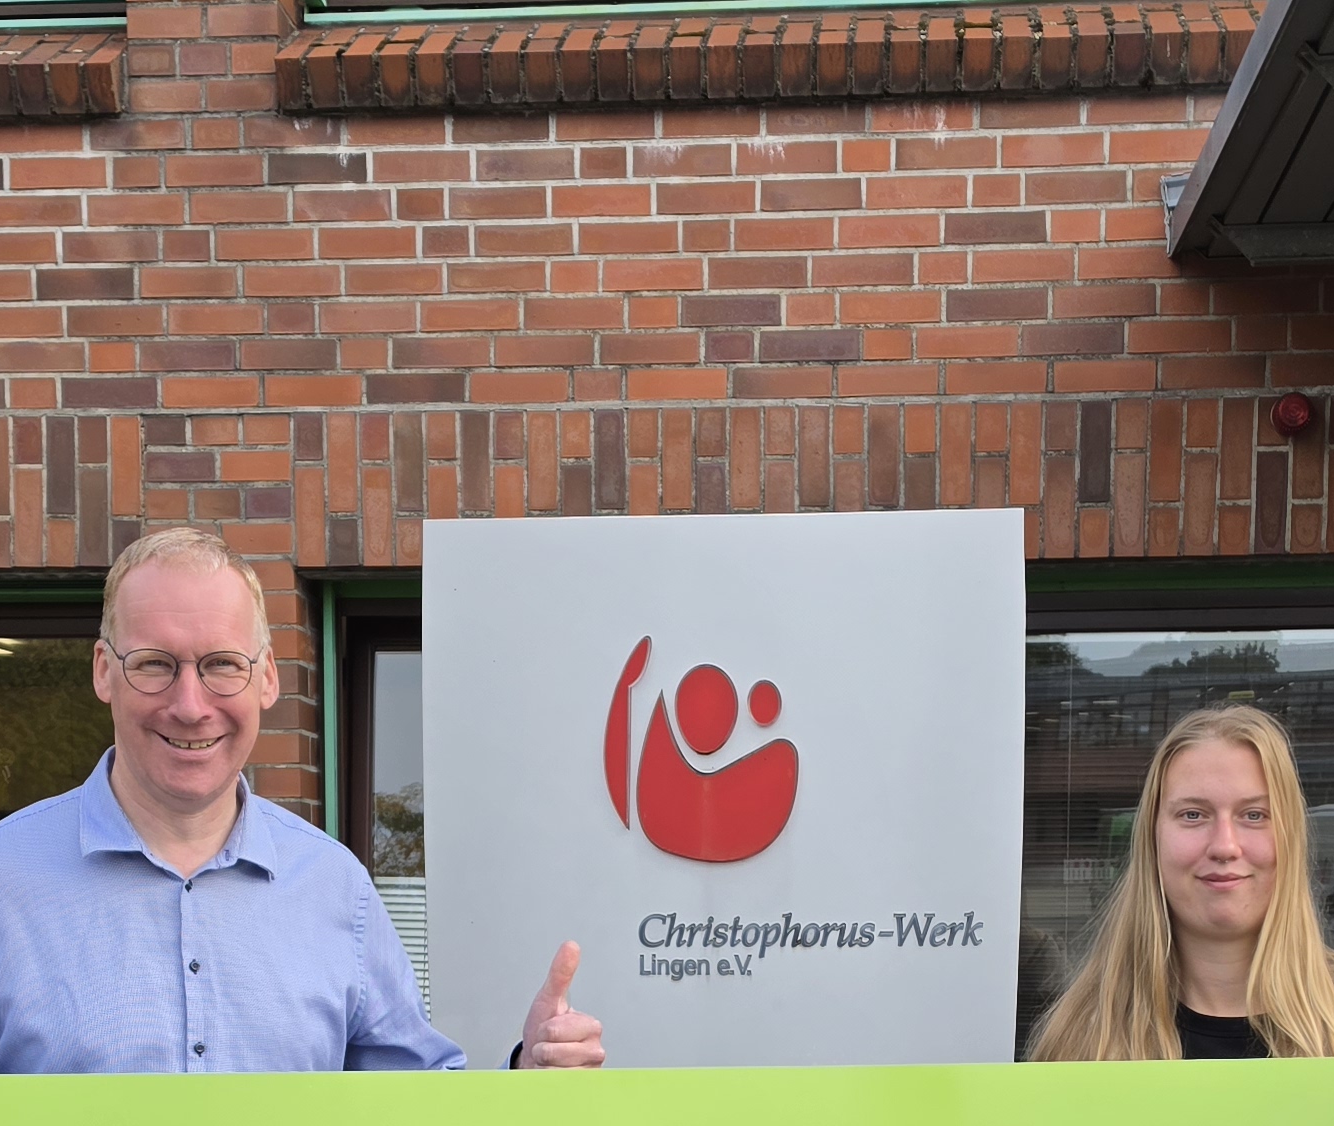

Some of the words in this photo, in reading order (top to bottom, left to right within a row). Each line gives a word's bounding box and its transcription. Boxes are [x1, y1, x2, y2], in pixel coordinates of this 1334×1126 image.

[638, 911, 984, 958] Christophorus-Werk
[639, 954, 710, 981] Lingen
[717, 954, 753, 976] e.V.
